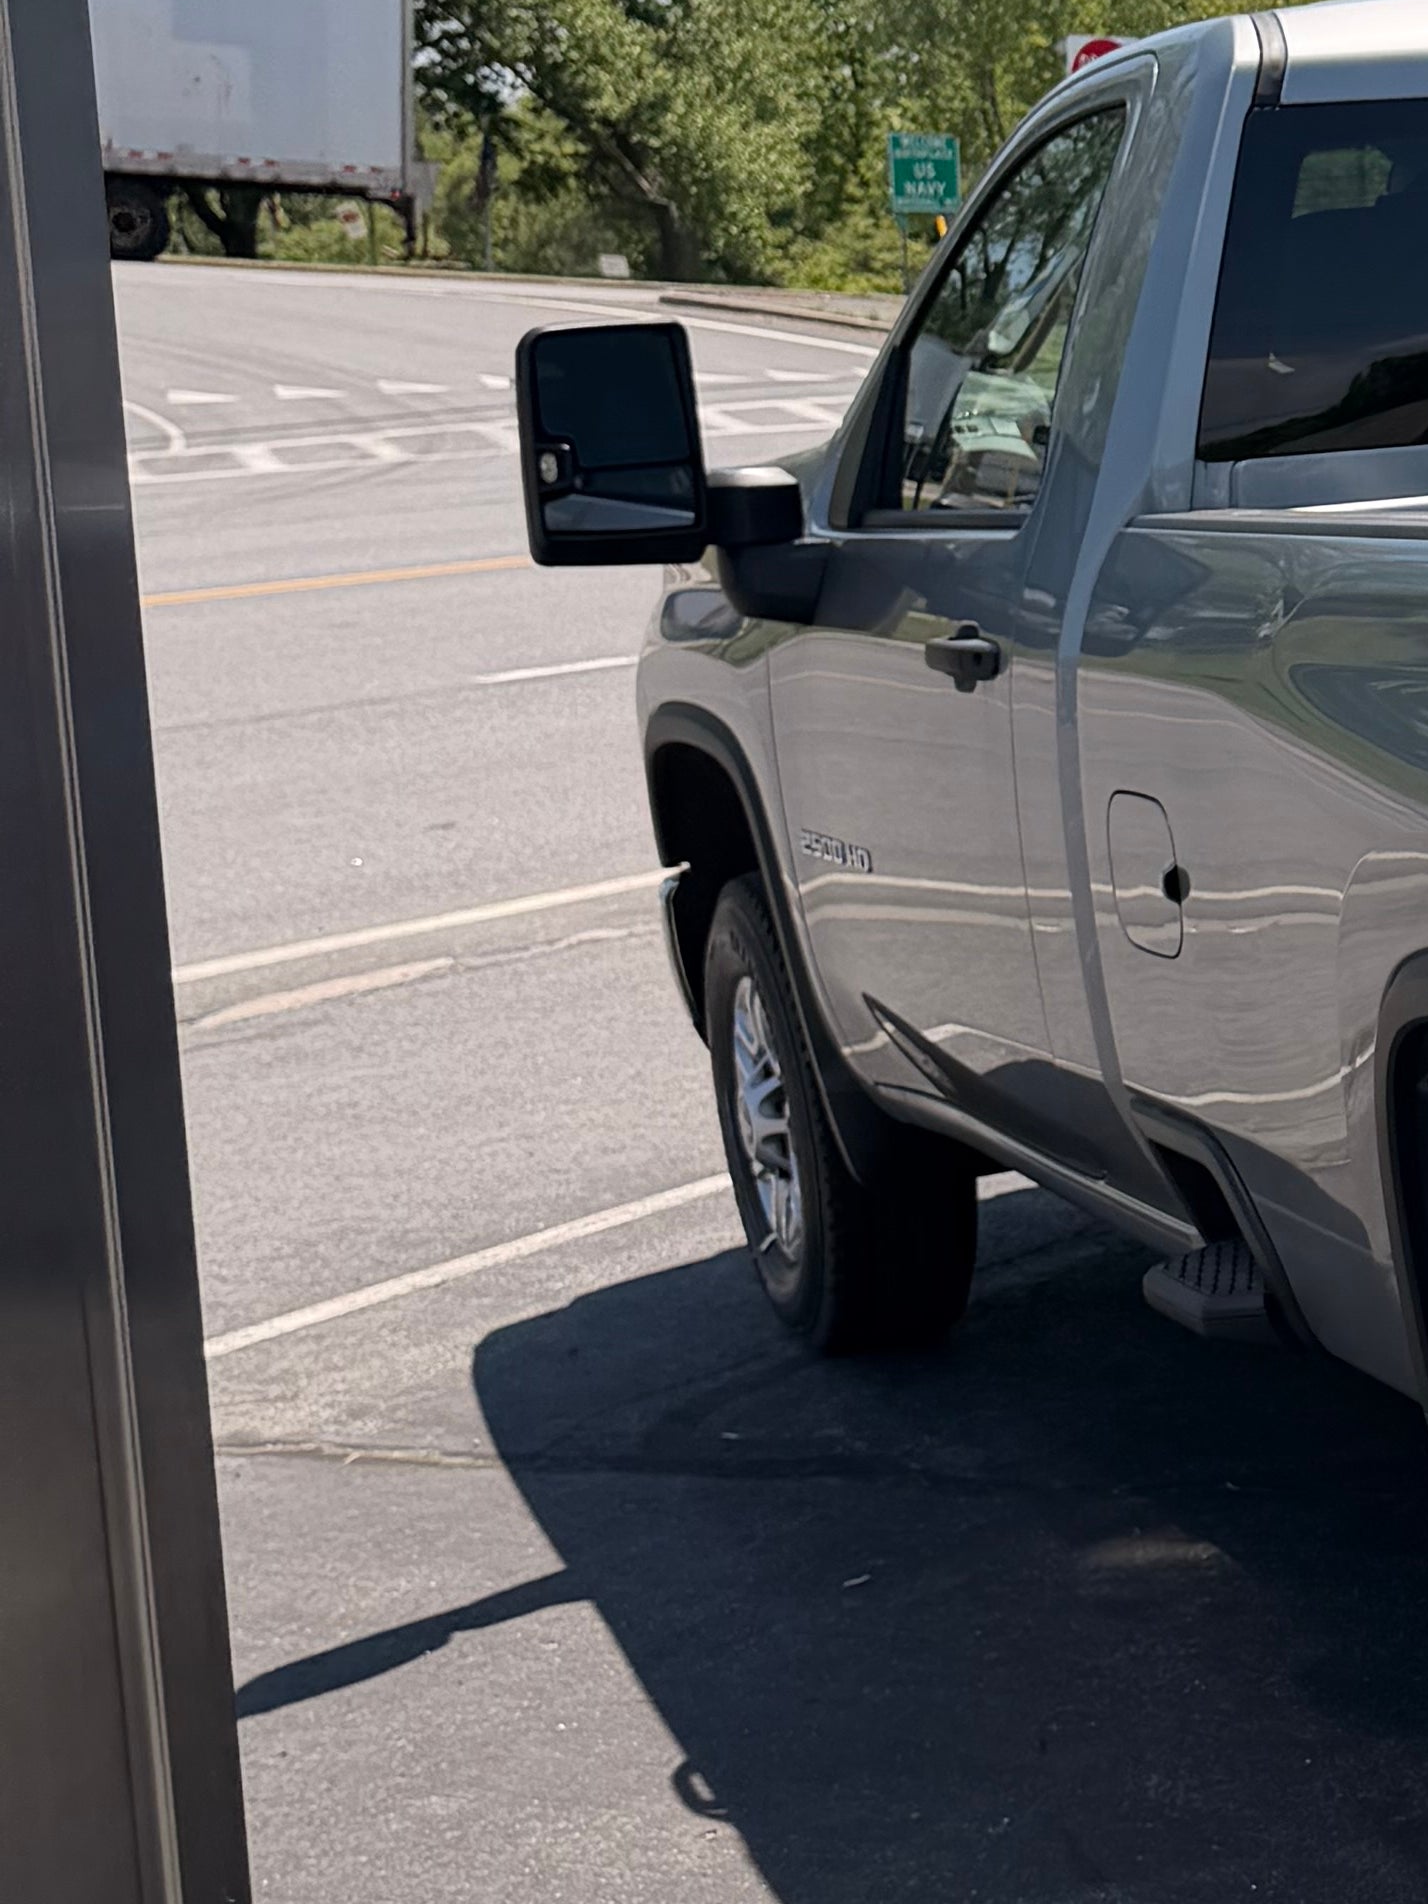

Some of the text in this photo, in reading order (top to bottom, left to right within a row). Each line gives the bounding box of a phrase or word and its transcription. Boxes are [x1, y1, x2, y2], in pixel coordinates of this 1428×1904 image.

[913, 162, 936, 179] US
[904, 181, 946, 196] NAVY
[800, 829, 871, 872] 2500 HD
